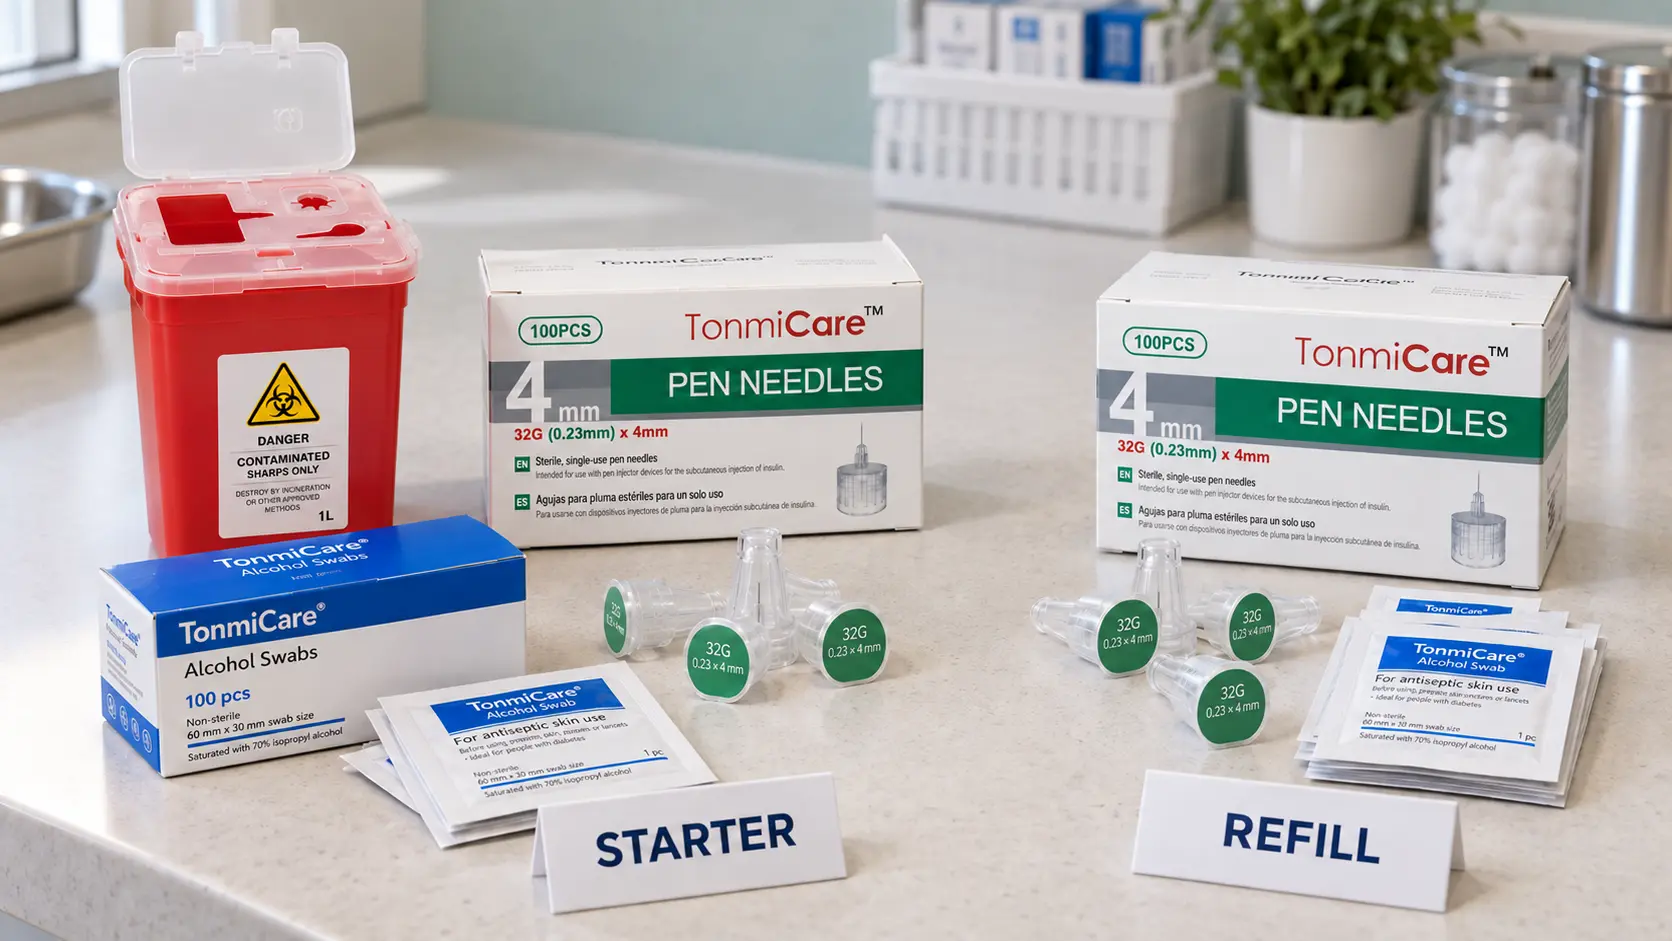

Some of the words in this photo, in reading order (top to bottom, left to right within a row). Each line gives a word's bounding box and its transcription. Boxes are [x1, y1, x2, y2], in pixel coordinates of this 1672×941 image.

[531, 323, 591, 338] 100PCS
[1134, 334, 1194, 352] 100PCS
[669, 371, 729, 397] PEN
[741, 366, 883, 395] NEEDLES
[506, 360, 551, 423] 4
[559, 405, 599, 422] mm
[1109, 370, 1154, 437] 4
[1161, 422, 1202, 440] mm
[1278, 397, 1342, 427] PEN
[1354, 403, 1507, 438] NEEDLES
[258, 434, 309, 446] DANGER
[514, 428, 542, 440] 32G
[549, 426, 615, 443] (0.23mm)
[620, 429, 628, 438] x
[633, 426, 668, 437] 4mm
[237, 451, 329, 467] CONTAMINATED
[1117, 440, 1145, 453] 32G
[1150, 442, 1217, 462] (0.23mm)
[1222, 451, 1230, 460] x
[1235, 449, 1269, 463] 4mm
[517, 460, 528, 468] EN
[536, 456, 564, 466] Sterile,
[566, 456, 607, 467] single-use
[610, 456, 624, 466] pen
[627, 454, 657, 463] needles
[247, 467, 289, 478] SHARPS
[292, 465, 319, 474] ONLY
[536, 471, 563, 479] Intended
[603, 470, 614, 478] pen
[616, 469, 638, 477] injector
[640, 468, 663, 476] devices
[686, 466, 727, 474] subcutaneous
[729, 465, 754, 474] injection
[756, 464, 761, 472] of
[1138, 469, 1164, 481] Sterile,
[1167, 472, 1206, 484] single-use
[1208, 476, 1223, 486] pen
[1225, 476, 1256, 487] needles
[236, 489, 268, 497] DESTROY
[536, 494, 565, 506] Agujas
[568, 494, 587, 505] para
[590, 493, 616, 504] pluma
[619, 492, 653, 502] estériles
[656, 492, 674, 502] para
[689, 490, 706, 499] solo
[709, 490, 723, 498] uso
[517, 498, 527, 506] ES
[1120, 506, 1130, 514] ES
[319, 511, 333, 521] 1L
[1139, 505, 1165, 518] Agujas
[1167, 510, 1185, 518] para
[1188, 510, 1212, 520] pluma
[1215, 512, 1247, 523] estériles
[1250, 516, 1267, 525] para
[1270, 517, 1279, 525] un
[1282, 518, 1298, 526] solo
[1301, 519, 1315, 528] uso
[242, 561, 308, 576] Alcohol
[312, 554, 368, 566] Swabs
[1117, 616, 1140, 632] 32G
[1243, 608, 1261, 624] 32G
[843, 625, 867, 641] 32G
[1232, 628, 1246, 640] 0.23
[1253, 626, 1258, 635] 4
[1259, 625, 1271, 634] mm
[706, 642, 730, 657] 32G
[1103, 637, 1122, 649] 0.23
[1131, 635, 1135, 644] 4
[1137, 634, 1152, 643] mm
[828, 646, 848, 658] 0.23
[857, 644, 862, 654] 4
[864, 644, 881, 653] mm
[184, 653, 255, 678] Alcohol
[261, 646, 318, 666] Swabs
[692, 657, 711, 670] 0.23
[720, 662, 725, 672] 4
[727, 665, 743, 674] mm
[1417, 657, 1467, 669] Alcohol
[1471, 662, 1505, 672] Swab
[1221, 684, 1244, 700] 32G
[1375, 674, 1395, 683] For
[1400, 676, 1463, 688] antiseptic
[1468, 681, 1492, 690] skin
[1498, 685, 1519, 694] use
[186, 692, 216, 708] 100
[222, 689, 250, 707] pcs
[487, 705, 537, 720] Alcohol
[540, 700, 576, 710] Swab
[1206, 705, 1225, 718] 0.23
[1236, 702, 1241, 712] 4
[1243, 702, 1259, 711] mm
[187, 712, 241, 727] Non-sterile
[188, 730, 199, 739] 60
[203, 729, 221, 737] mm
[233, 723, 244, 731] 30
[247, 722, 265, 730] mm
[268, 715, 293, 726] swab
[296, 712, 314, 721] size
[454, 736, 477, 745] For
[483, 721, 549, 739] antiseptic
[552, 716, 580, 727] skin
[583, 714, 606, 723] use
[188, 747, 229, 761] Saturated
[232, 743, 250, 753] with
[253, 739, 270, 749] 70%
[273, 734, 310, 746] isopropyl
[313, 727, 342, 739] alcohol
[1360, 732, 1394, 741] Saturated
[1397, 734, 1412, 742] with
[1415, 736, 1431, 744] 70%
[1433, 739, 1468, 749] isopropyl
[1469, 742, 1496, 751] alcohol
[653, 749, 664, 757] pc
[484, 786, 524, 798] Saturated
[526, 782, 543, 791] with
[545, 779, 563, 787] 70%
[564, 773, 602, 784] isopropyl
[604, 768, 632, 778] alcohol
[596, 813, 796, 867] STARTER
[1223, 812, 1380, 864] REFILL
